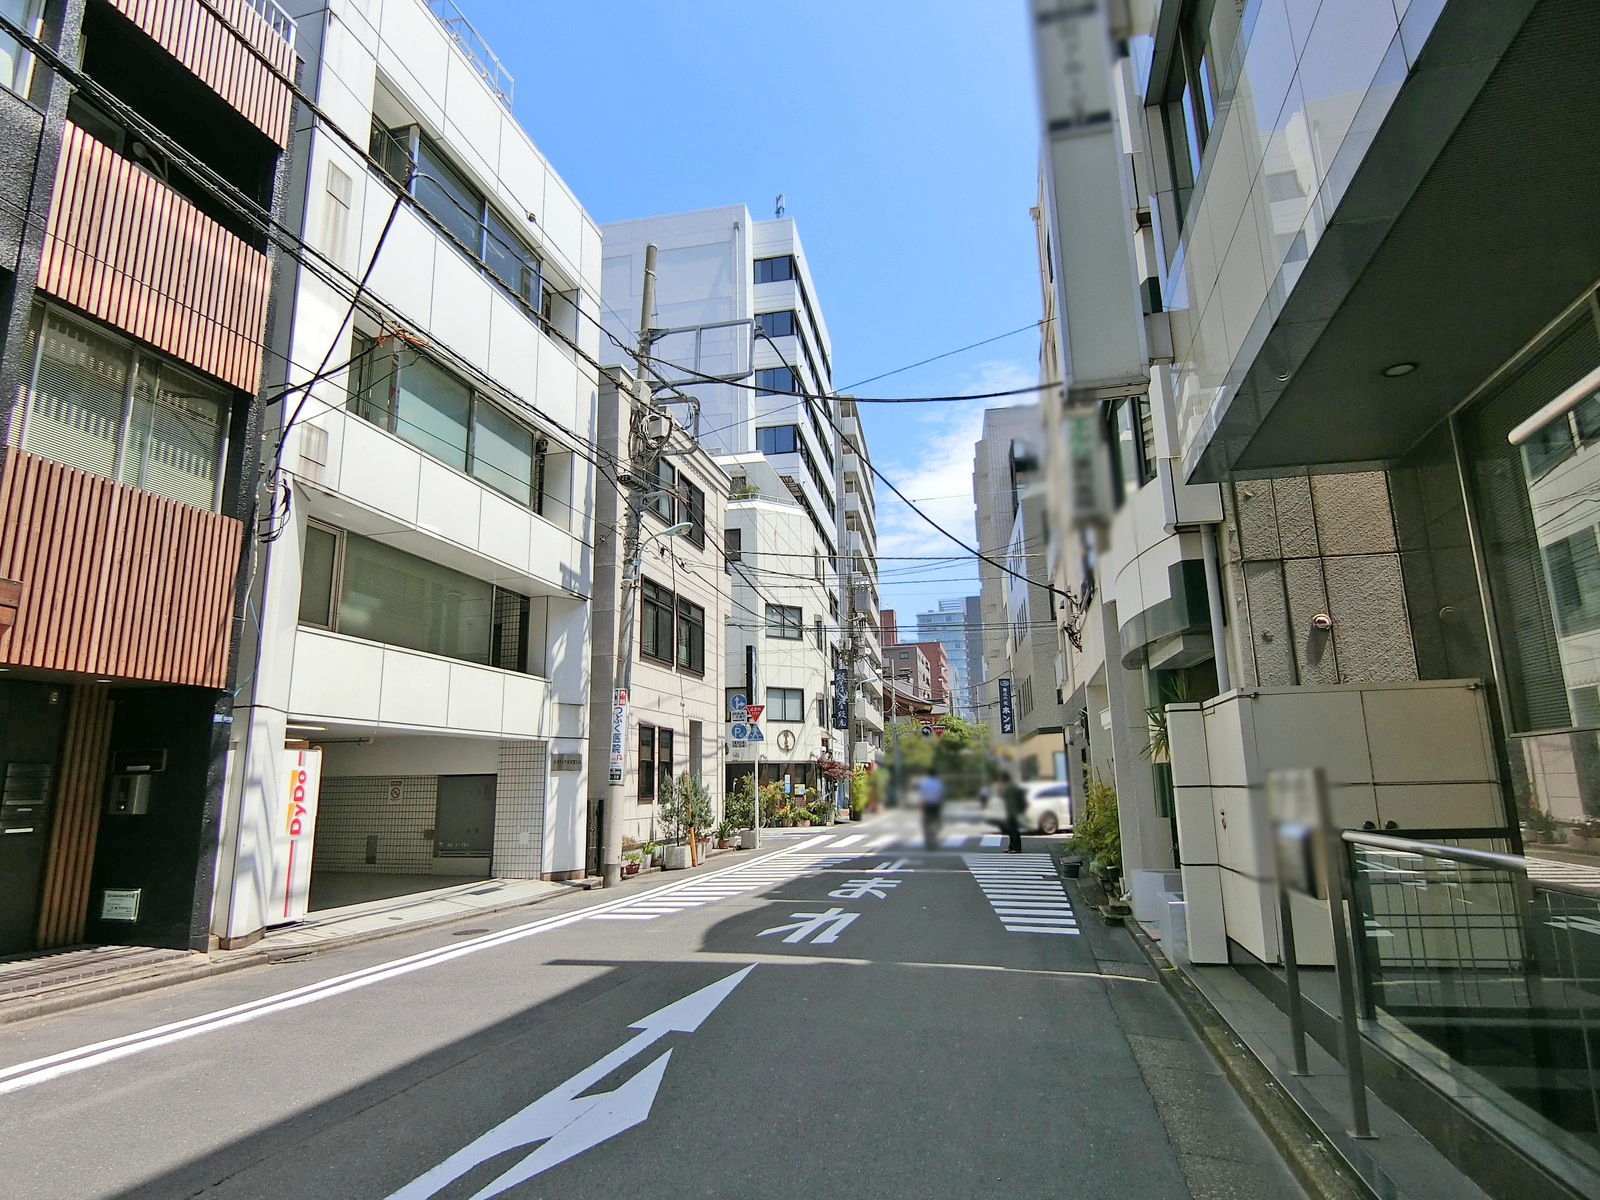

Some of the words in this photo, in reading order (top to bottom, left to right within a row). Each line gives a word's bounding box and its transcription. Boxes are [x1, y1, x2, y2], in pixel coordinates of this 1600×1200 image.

[613, 706, 623, 753] つぶく医院
[289, 770, 307, 835] DyDo
